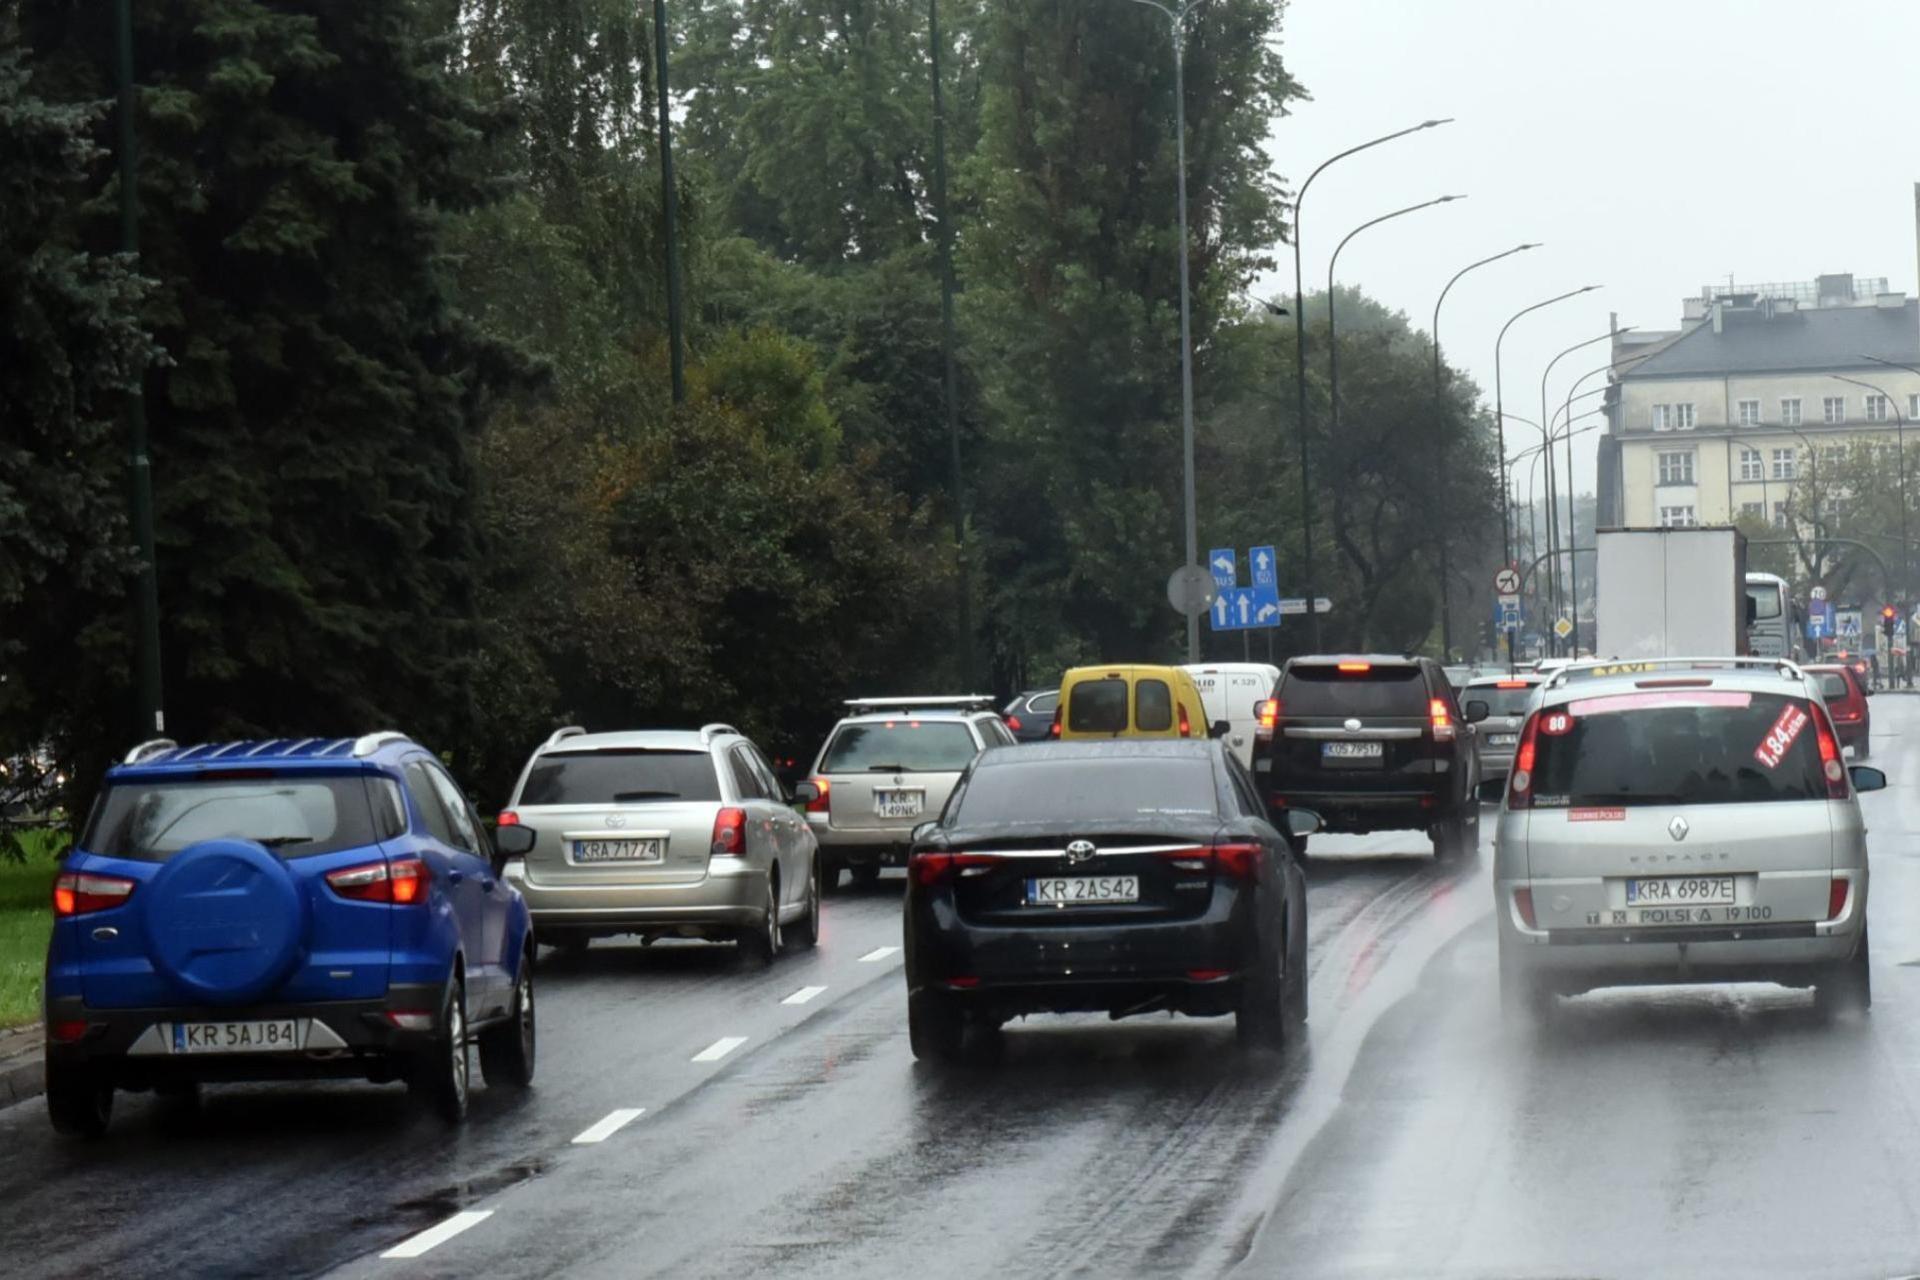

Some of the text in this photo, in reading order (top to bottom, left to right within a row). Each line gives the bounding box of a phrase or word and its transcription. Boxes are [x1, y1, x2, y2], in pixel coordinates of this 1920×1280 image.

[1549, 715, 1566, 731] 80
[1757, 726, 1791, 768] 1,84
[890, 791, 907, 804] KR
[582, 841, 657, 857] KRA 71774
[1039, 878, 1135, 900] KR 2AS42
[1638, 879, 1732, 900] KRA 6987E
[1640, 908, 1713, 923] POLSKA
[1745, 905, 1773, 920] 100
[187, 1022, 293, 1046] KR 5AJ84
